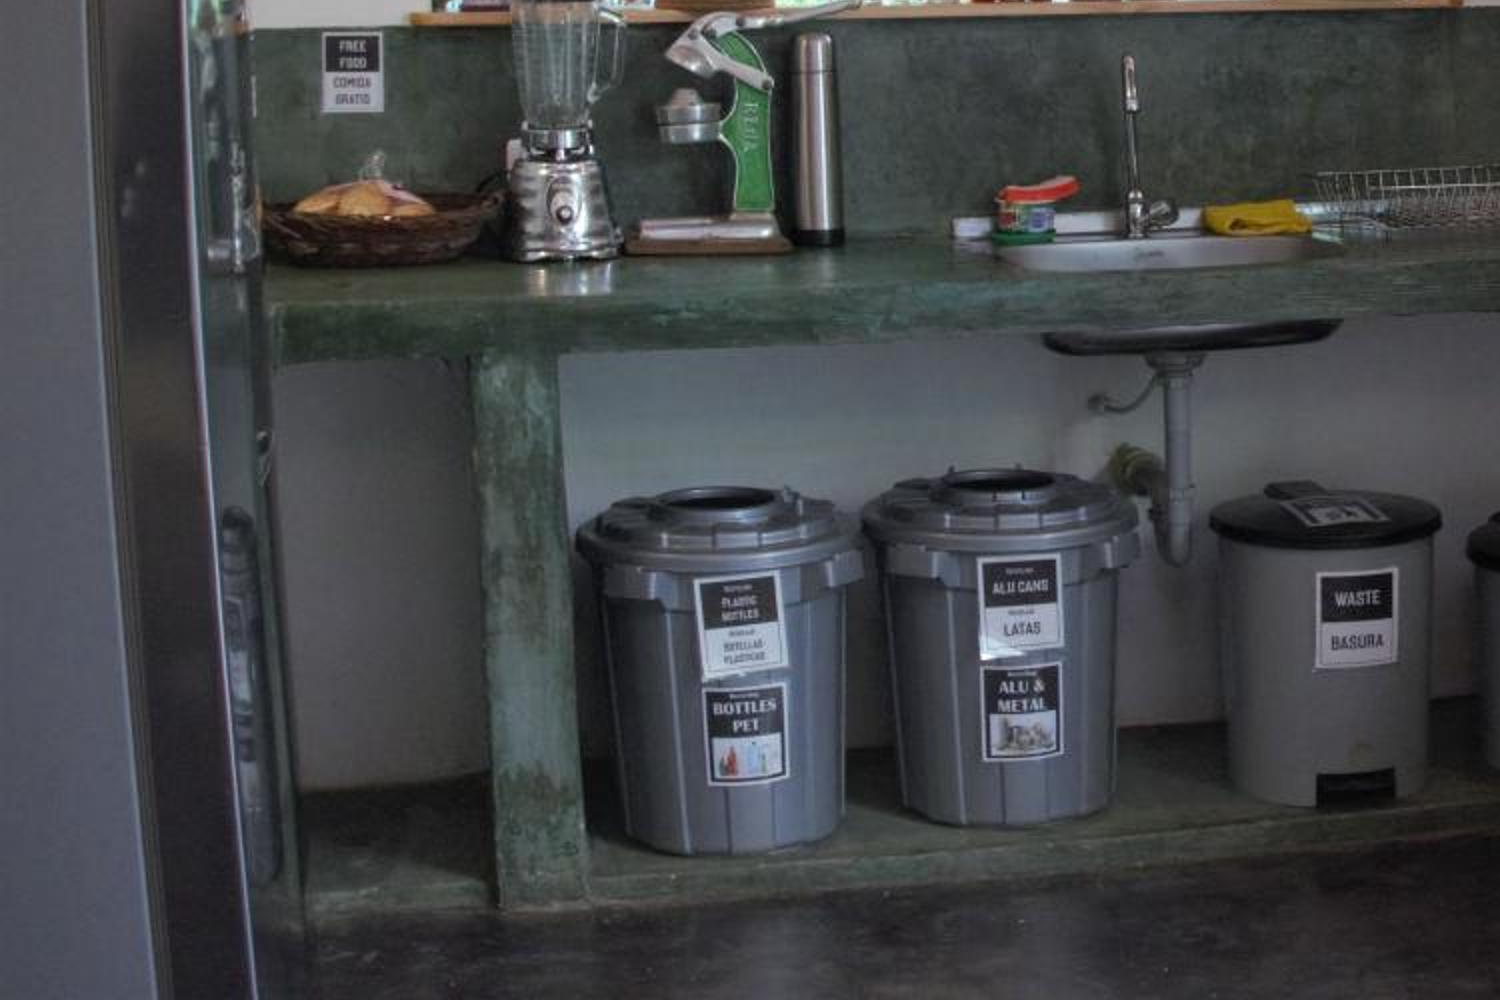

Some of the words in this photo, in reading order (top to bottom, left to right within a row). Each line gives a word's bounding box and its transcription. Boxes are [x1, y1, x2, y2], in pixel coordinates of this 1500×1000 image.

[339, 39, 367, 53] FREE
[339, 56, 367, 69] FOOD
[333, 77, 371, 89] COMIDA
[992, 580, 1016, 595] ALU
[1017, 578, 1049, 593] CANS
[720, 594, 758, 609] PLASTIC
[1334, 588, 1381, 607] WASTE
[720, 607, 760, 622] BOTTLES
[1003, 621, 1041, 637] LATAS
[1331, 633, 1385, 651] BASURA
[998, 679, 1029, 695] ALU
[1032, 678, 1046, 693] &
[712, 697, 777, 716] BOTTLES
[997, 696, 1048, 713] METAL
[732, 717, 760, 733] PET
